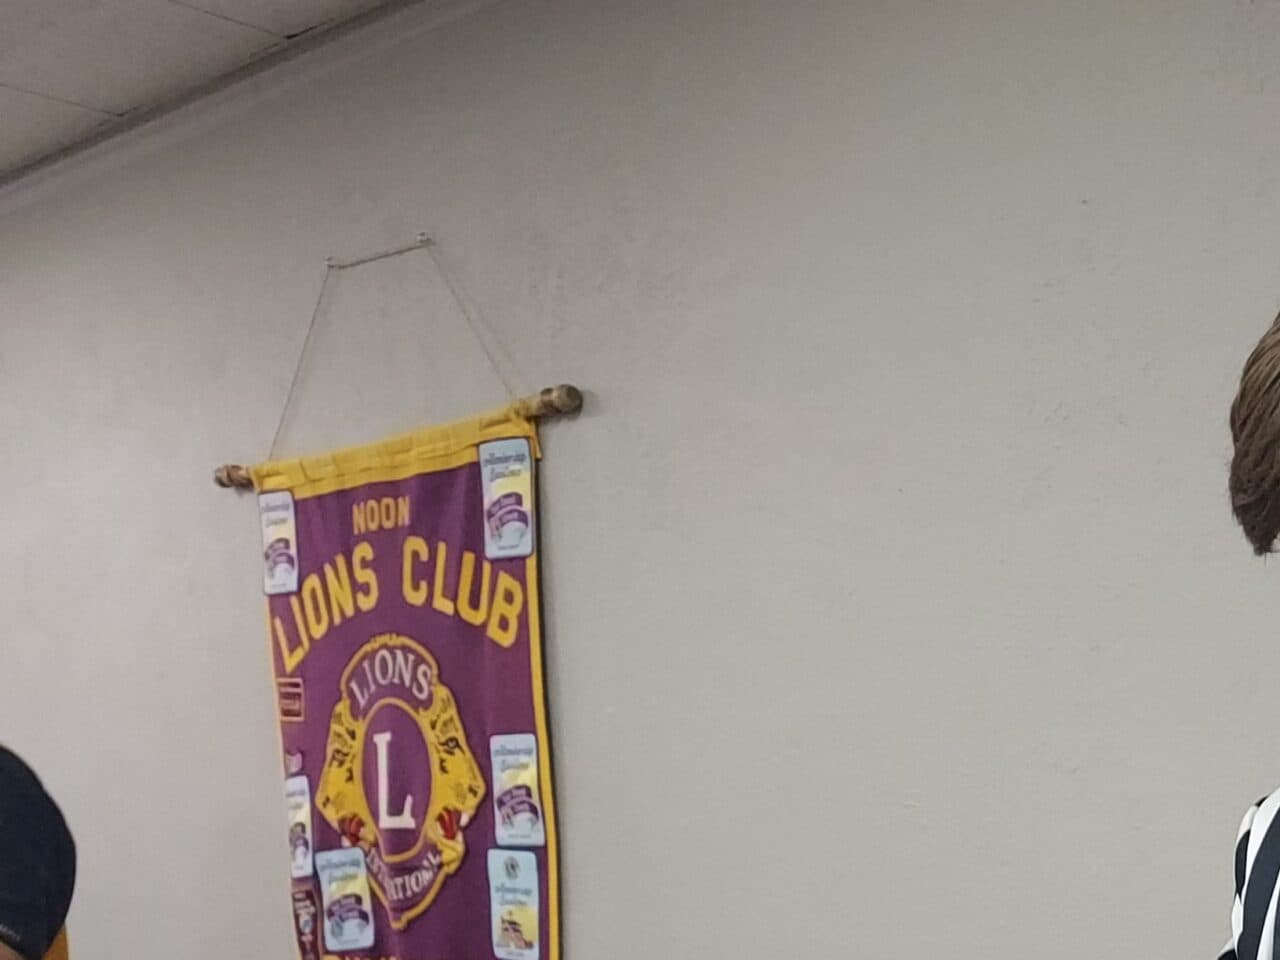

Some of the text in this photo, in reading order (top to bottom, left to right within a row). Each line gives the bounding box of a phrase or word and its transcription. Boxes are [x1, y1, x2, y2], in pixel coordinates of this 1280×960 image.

[353, 497, 410, 534] NOON
[275, 536, 523, 674] LIONS CLUB
[350, 648, 433, 709] LIONS
[373, 731, 416, 829] L
